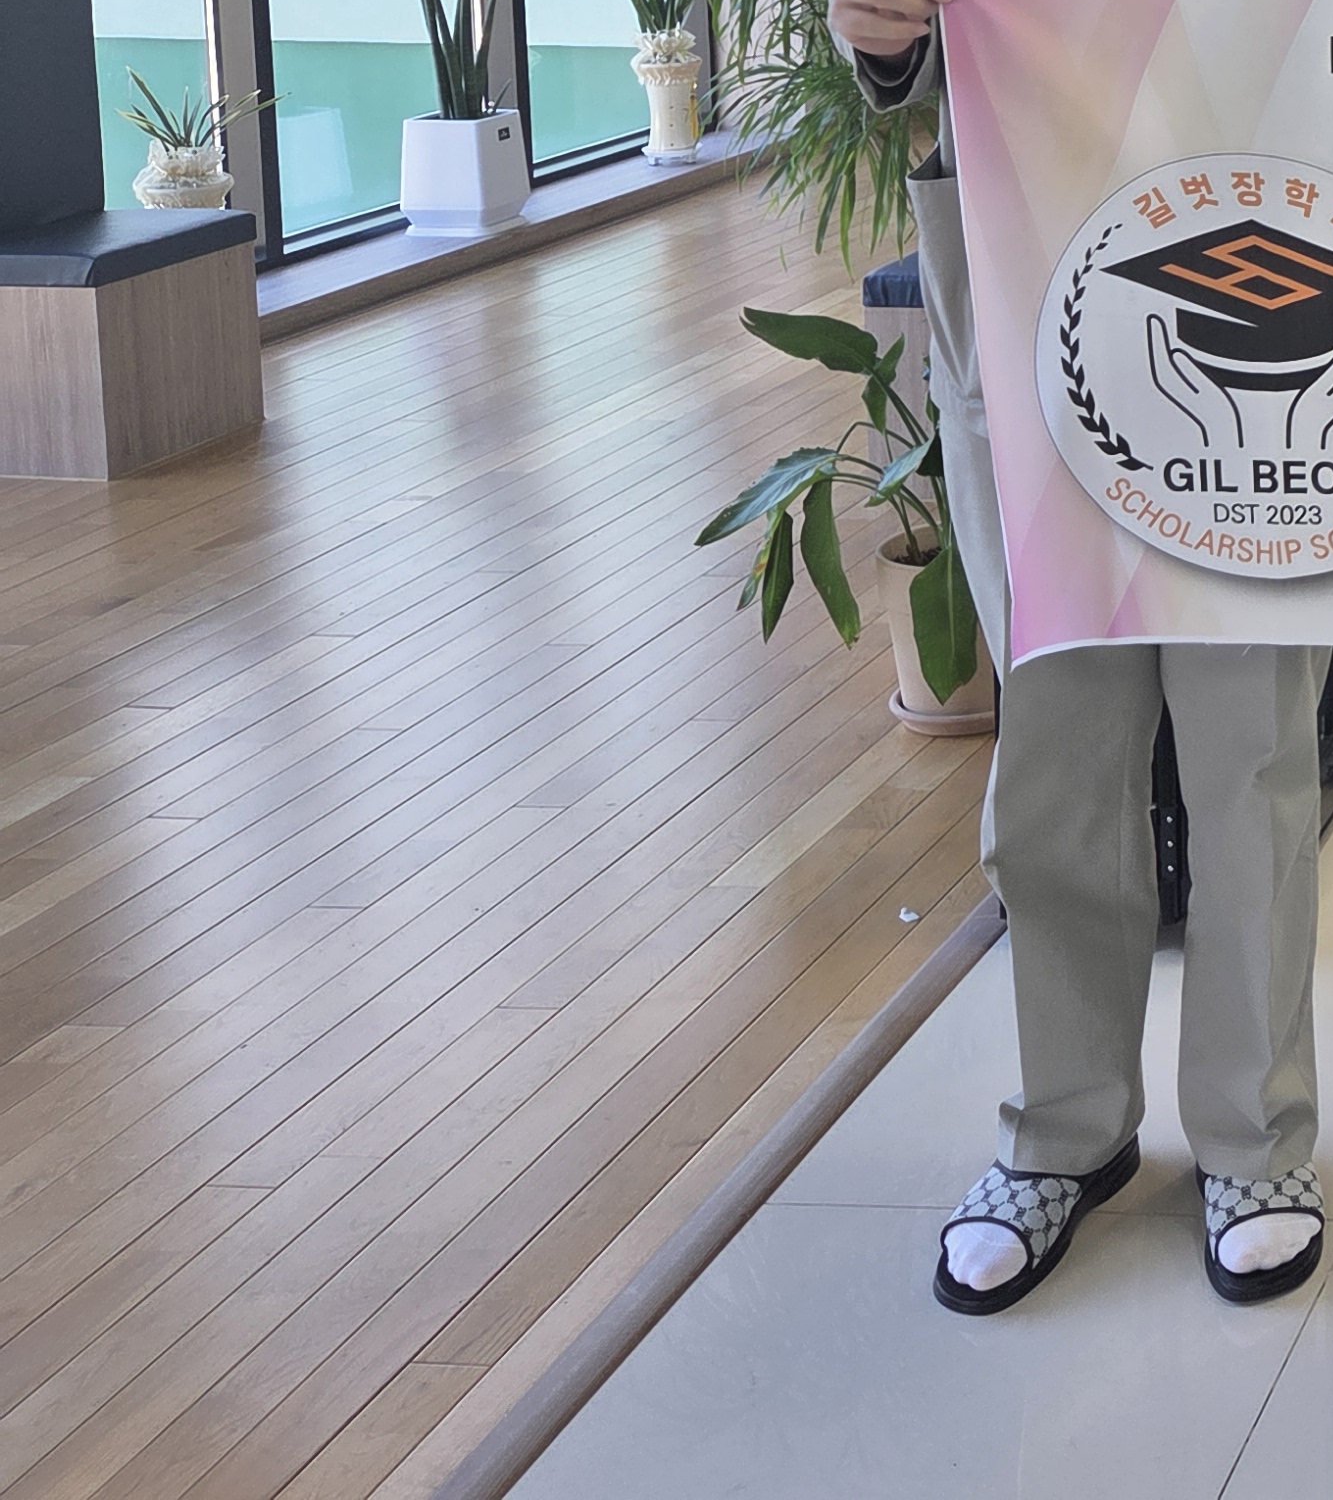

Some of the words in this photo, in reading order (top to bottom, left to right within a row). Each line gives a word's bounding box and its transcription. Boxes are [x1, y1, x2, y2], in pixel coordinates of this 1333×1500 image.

[1162, 457, 1239, 493] GIL
[1104, 477, 1302, 566] SCHOLARSHIP
[1212, 502, 1260, 525] DST
[1265, 504, 1323, 526] 2023
